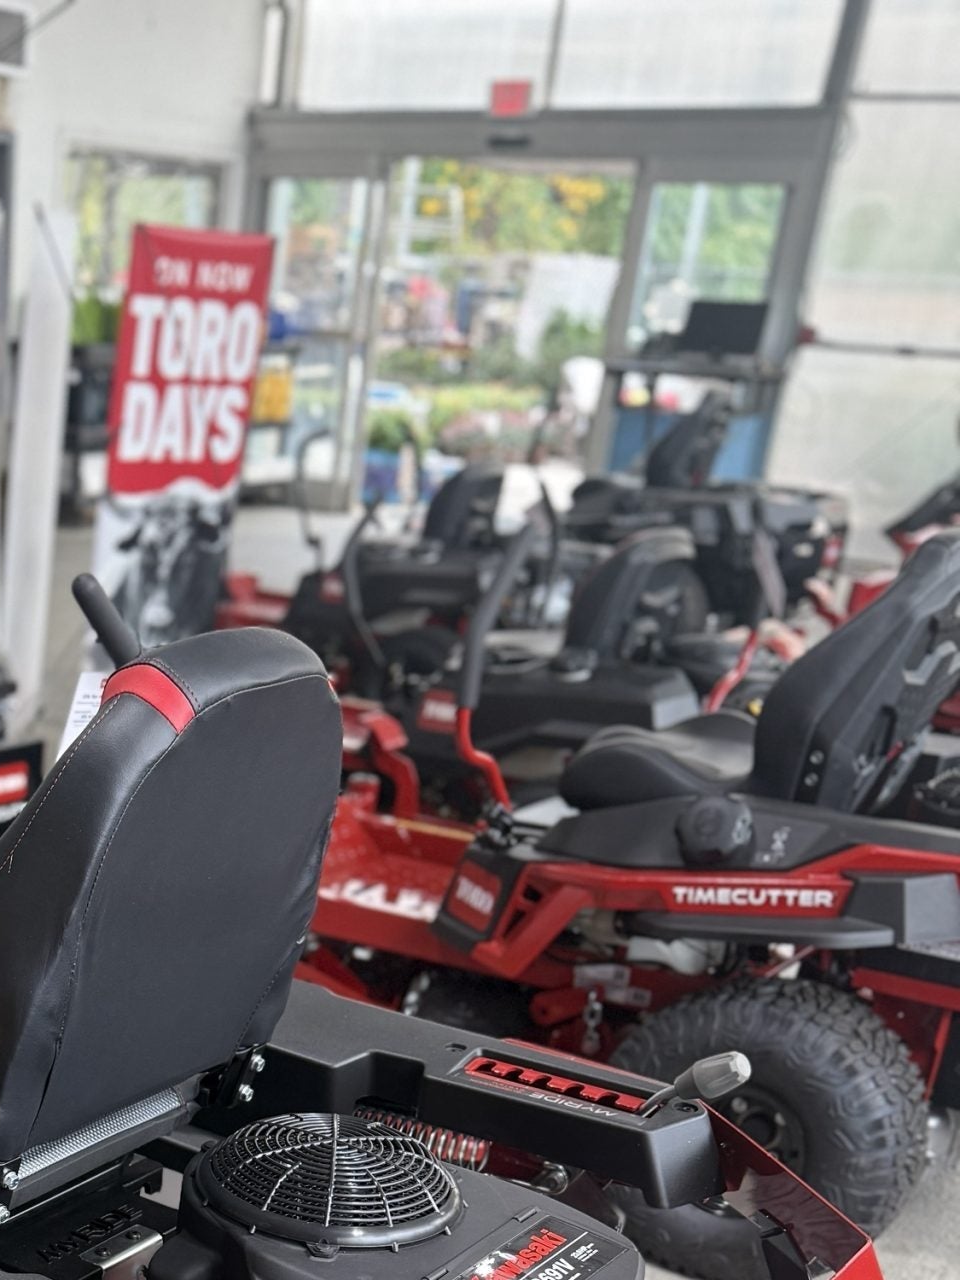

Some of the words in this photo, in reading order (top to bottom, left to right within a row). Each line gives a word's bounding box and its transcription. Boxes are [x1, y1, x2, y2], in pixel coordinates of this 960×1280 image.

[153, 255, 191, 289] ON
[194, 260, 254, 294] NOW
[128, 293, 262, 384] TORO
[116, 379, 250, 465] DAYS
[672, 885, 836, 908] TIMECUTTER
